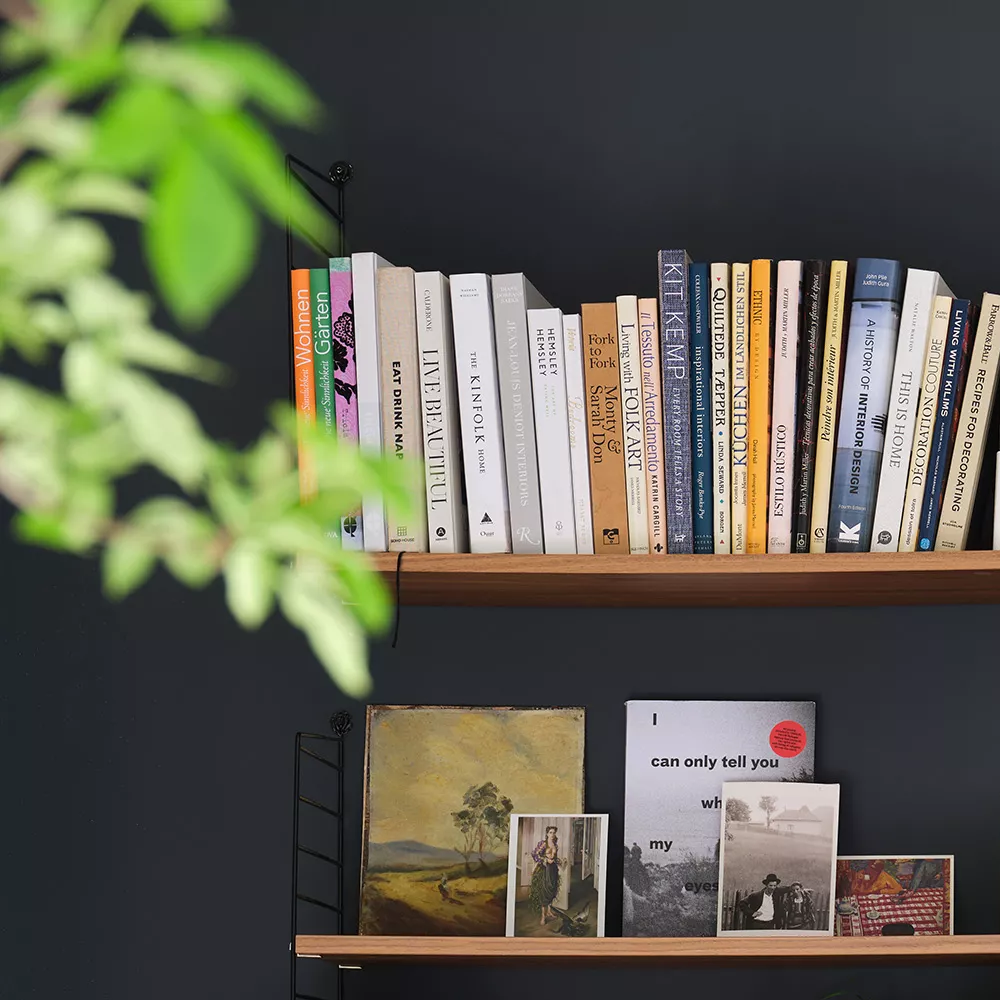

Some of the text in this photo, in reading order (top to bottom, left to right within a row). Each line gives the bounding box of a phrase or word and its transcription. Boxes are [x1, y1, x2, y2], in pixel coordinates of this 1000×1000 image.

[664, 263, 683, 300] KIT
[736, 271, 745, 293] STIL
[296, 289, 312, 366] Wohnen
[314, 292, 331, 356] Gärten
[713, 288, 727, 360] QUILTEDE
[735, 296, 745, 363] LÄNDLICHEN
[753, 290, 762, 325] ETHNIC
[536, 329, 546, 376] HEMSLEY
[548, 328, 557, 376] HEMSLEY
[588, 334, 615, 345] Fork
[590, 347, 602, 356] to
[590, 357, 616, 368] Fork
[620, 324, 635, 358] Living
[641, 322, 655, 368] Tessuto
[665, 312, 685, 379] KEMP
[861, 330, 875, 374] HISTORY
[318, 361, 330, 406] Sinnlichkeit
[624, 361, 633, 383] with
[736, 366, 745, 380] IM
[861, 376, 870, 390] OF
[940, 310, 963, 417] LIVING WITH KILIMS
[392, 361, 404, 460] EAT DRINK NAP
[470, 376, 485, 444] KINFOLK
[506, 320, 528, 507] JEAN-LOUIS DENIOT INTERIORS
[625, 387, 640, 432] FOLK
[672, 388, 681, 416] EVERY
[694, 346, 705, 458] inspirational interiors
[716, 369, 726, 427] TÆPPER
[821, 345, 836, 442] Peindre son intérieur
[912, 396, 934, 486] DÉCORATION
[925, 339, 943, 393] COUTURE
[970, 369, 986, 414] RECIPES
[422, 350, 447, 510] LIVE BEAUTIFUL
[590, 385, 605, 464] Sarah Don
[602, 386, 620, 454] Monty &
[732, 385, 747, 466] KÜCHEN
[854, 393, 868, 447] INTERIOR
[890, 371, 913, 468] THIS IS HOME
[965, 416, 976, 439] FOR
[628, 436, 642, 471] ART
[774, 424, 786, 517] ESTILO RÚSTICO
[849, 450, 861, 494] DESIGN
[951, 441, 972, 512] DECORATING
[653, 713, 657, 725] I
[651, 755, 779, 770] can only tell you
[650, 840, 673, 852] my
[685, 882, 718, 894] eyes
